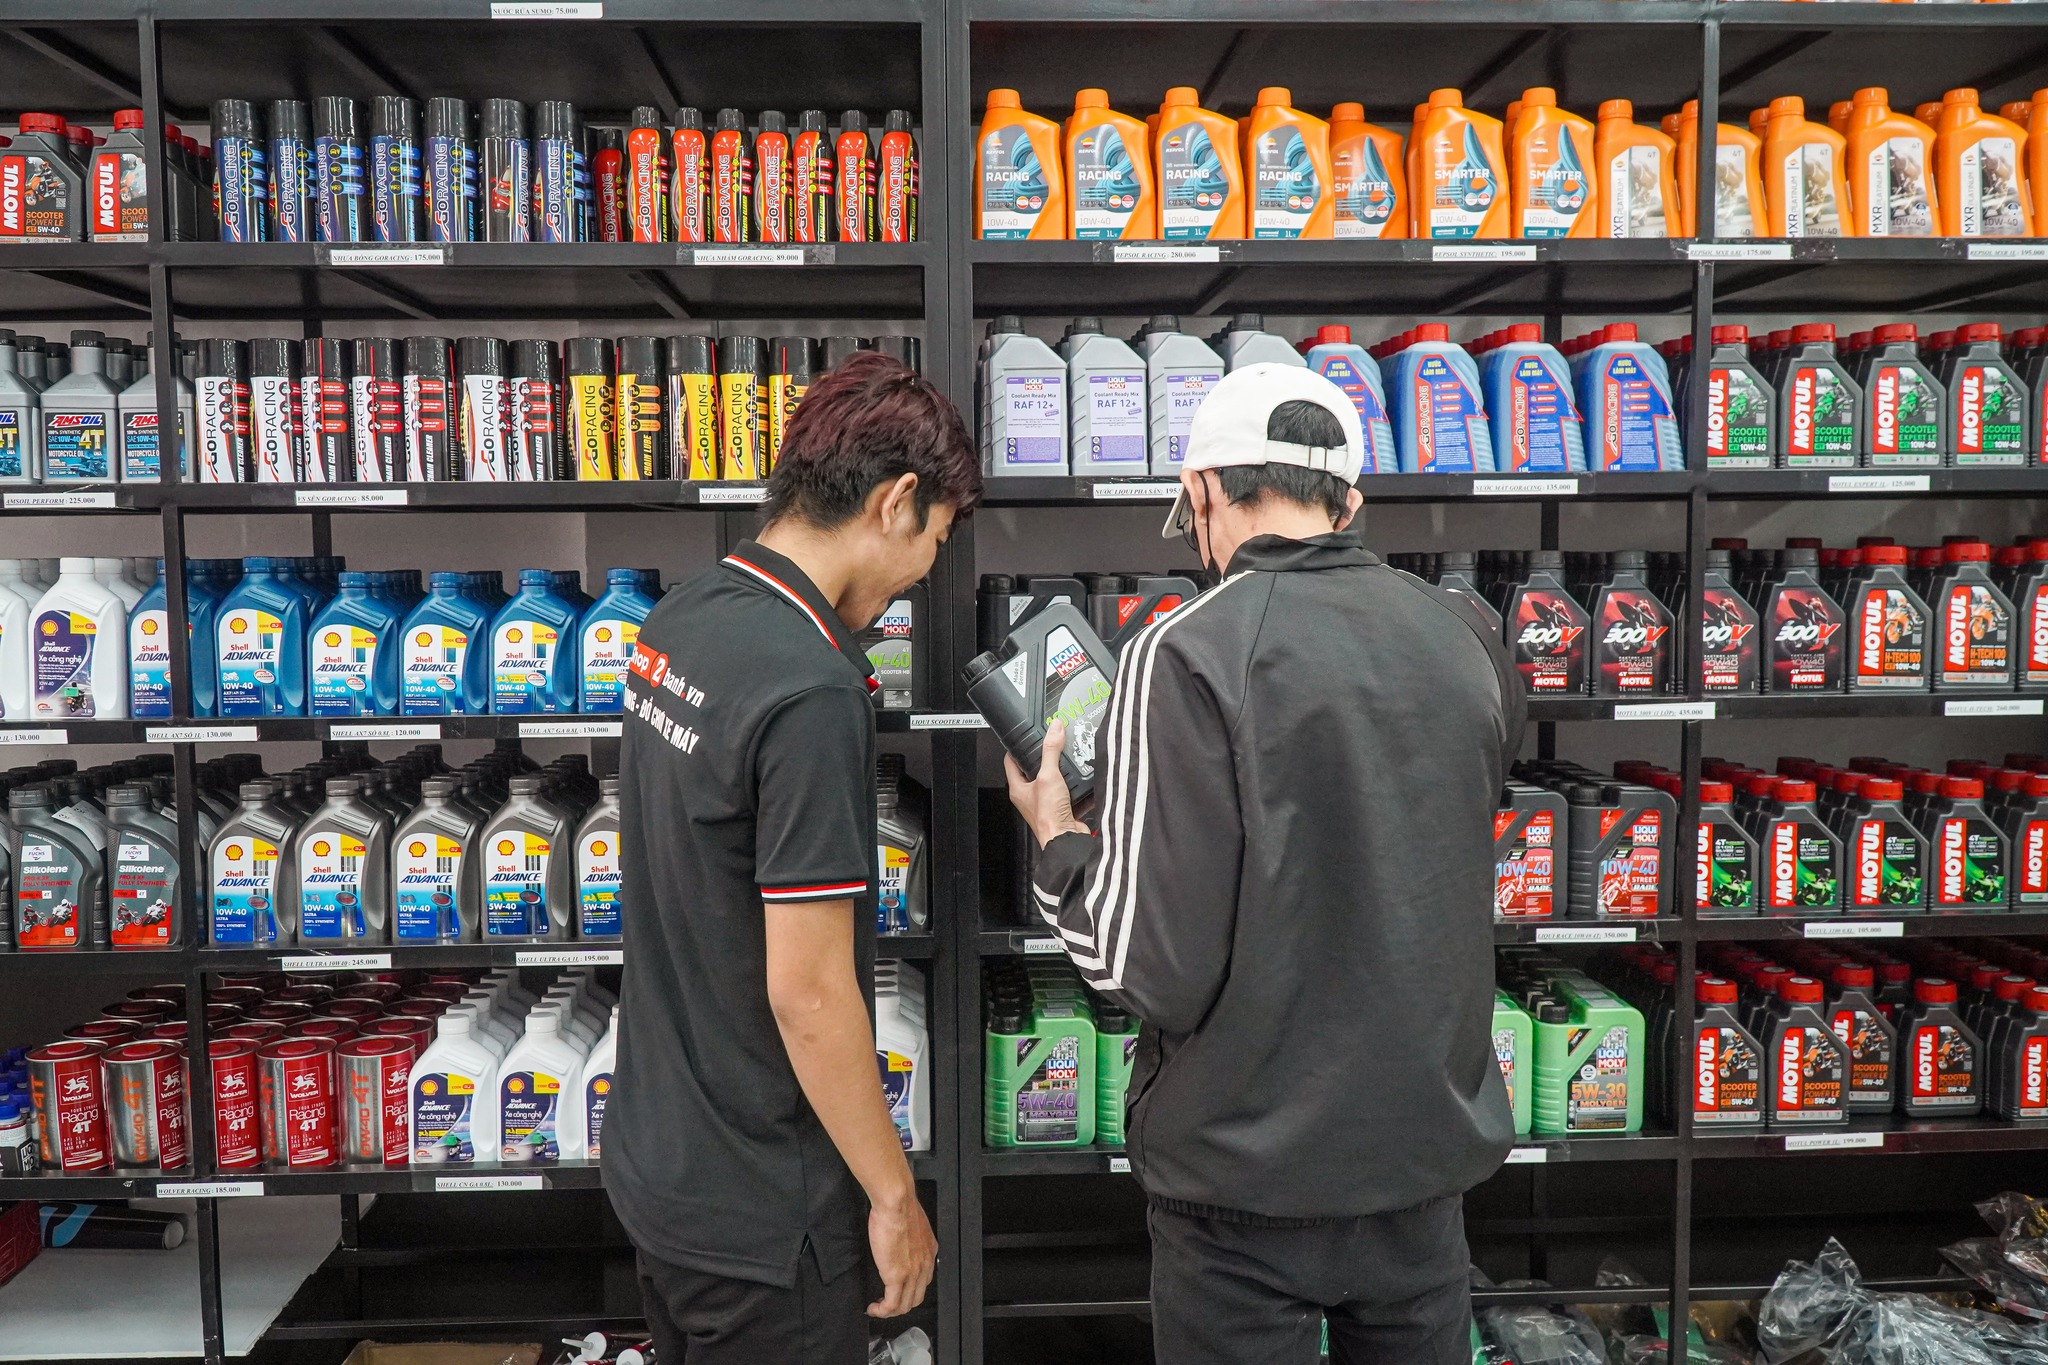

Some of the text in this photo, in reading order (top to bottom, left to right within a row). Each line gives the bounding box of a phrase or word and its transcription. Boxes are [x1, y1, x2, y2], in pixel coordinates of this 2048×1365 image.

[556, 7, 579, 15] 75.000
[986, 171, 1030, 182] RACING
[1078, 169, 1122, 181] RACING
[1165, 168, 1210, 180] RACING
[1259, 171, 1302, 182] RACING
[1434, 169, 1490, 180] SMARTER
[1529, 171, 1582, 181] SMARTER
[1334, 182, 1388, 193] SMARTER
[3, 164, 19, 229] MOTUL
[26, 211, 64, 219] SCOOTER
[26, 219, 64, 227] POWER LE
[1171, 250, 1196, 258] 280.000
[1501, 250, 1526, 258] 195.000
[1031, 393, 1045, 401] Ready
[1014, 401, 1054, 410] RAF 12+
[1097, 400, 1137, 408] RAF 12+
[1175, 399, 1195, 408] RAF
[48, 414, 104, 427] AMSOIL
[264, 380, 278, 482] GORACING
[481, 379, 496, 481] GORACING
[1728, 427, 1767, 436] SCOOTER
[1815, 426, 1852, 435] SCOOTER
[1898, 425, 1937, 434] SCOOTER
[1728, 435, 1756, 444] EXPERT
[643, 434, 656, 477] CHAIN LUBE
[760, 455, 769, 476] CHAIN
[69, 496, 96, 505] 225.000
[885, 617, 910, 626] LIQUI
[885, 626, 910, 635] MOLY
[1775, 624, 1841, 641] 300V
[1864, 597, 1881, 669] MOTUL
[1949, 594, 1967, 666] MOTUL
[1517, 627, 1584, 645] 300V
[1603, 626, 1669, 644] 300V
[39, 655, 82, 665] Xe công nghệ
[222, 651, 275, 661] ADVANCE
[1050, 645, 1080, 667] LIQUI
[1885, 650, 1921, 662] H-TECH 100
[497, 660, 548, 669] ADVANCE
[1056, 653, 1087, 678] MOLY
[1533, 661, 1567, 670] 10W40
[1619, 660, 1653, 668] 10W40
[1790, 658, 1825, 667] 10W40
[315, 664, 366, 673] ADVANCE
[407, 664, 458, 673] ADVANCE
[652, 657, 666, 683] 2
[1017, 660, 1026, 687] Germany
[1533, 677, 1566, 687] MOTUL
[223, 683, 253, 692] 10W-40
[315, 686, 346, 695] 10W-40
[405, 685, 436, 694] 10W-40
[662, 716, 674, 742] XE
[670, 726, 700, 755] MÁY
[1526, 827, 1550, 835] LIQUI
[1633, 825, 1657, 833] LIQUI
[1527, 835, 1550, 843] MOLY
[1633, 834, 1657, 843] MOLY
[28, 850, 46, 858] FUCHS
[1860, 823, 1880, 899] MOTUL
[1944, 821, 1963, 897] MOTUL
[23, 866, 68, 874] Silkolene
[119, 865, 164, 873] Silkolene
[313, 866, 331, 875] Shell
[409, 867, 427, 876] Shell
[497, 865, 516, 874] Shell
[591, 866, 610, 875] Shell
[1496, 862, 1551, 877] 10W-40
[1601, 860, 1657, 875] 10W-40
[225, 870, 244, 879] Shell
[305, 873, 358, 883] ADVANCE
[400, 874, 453, 884] ADVANCE
[217, 877, 270, 887] ADVANCE
[1631, 876, 1656, 884] STREET
[489, 902, 517, 911] 5W-40
[583, 902, 611, 911] 5W-40
[216, 908, 247, 917] 10W-40
[352, 959, 378, 967] 245.000
[584, 955, 610, 963] 195.000
[1597, 1048, 1625, 1059] LIQUI
[1047, 1060, 1076, 1070] LIQUI
[1598, 1059, 1624, 1068] MOLY
[1918, 1033, 1932, 1092] MOTUL
[1047, 1069, 1076, 1079] MOLY
[1698, 1036, 1715, 1106] MOTUL
[2026, 1044, 2042, 1103] MOTUL
[1571, 1082, 1626, 1099] 5W-30
[1804, 1082, 1840, 1090] SCOOTER
[289, 1090, 319, 1099] WOLVER
[1017, 1092, 1075, 1111] 5W-40
[1579, 1099, 1626, 1107] MOLYGEN
[61, 1109, 98, 1124] Racing
[218, 1105, 254, 1121] Racing
[289, 1105, 325, 1121] Racing
[427, 1112, 441, 1121] công
[442, 1112, 457, 1121] nghệ
[1029, 1110, 1076, 1119] MOLYGEN
[72, 1120, 91, 1134] 4T
[229, 1117, 247, 1131] 4T
[299, 1117, 319, 1132] 4T
